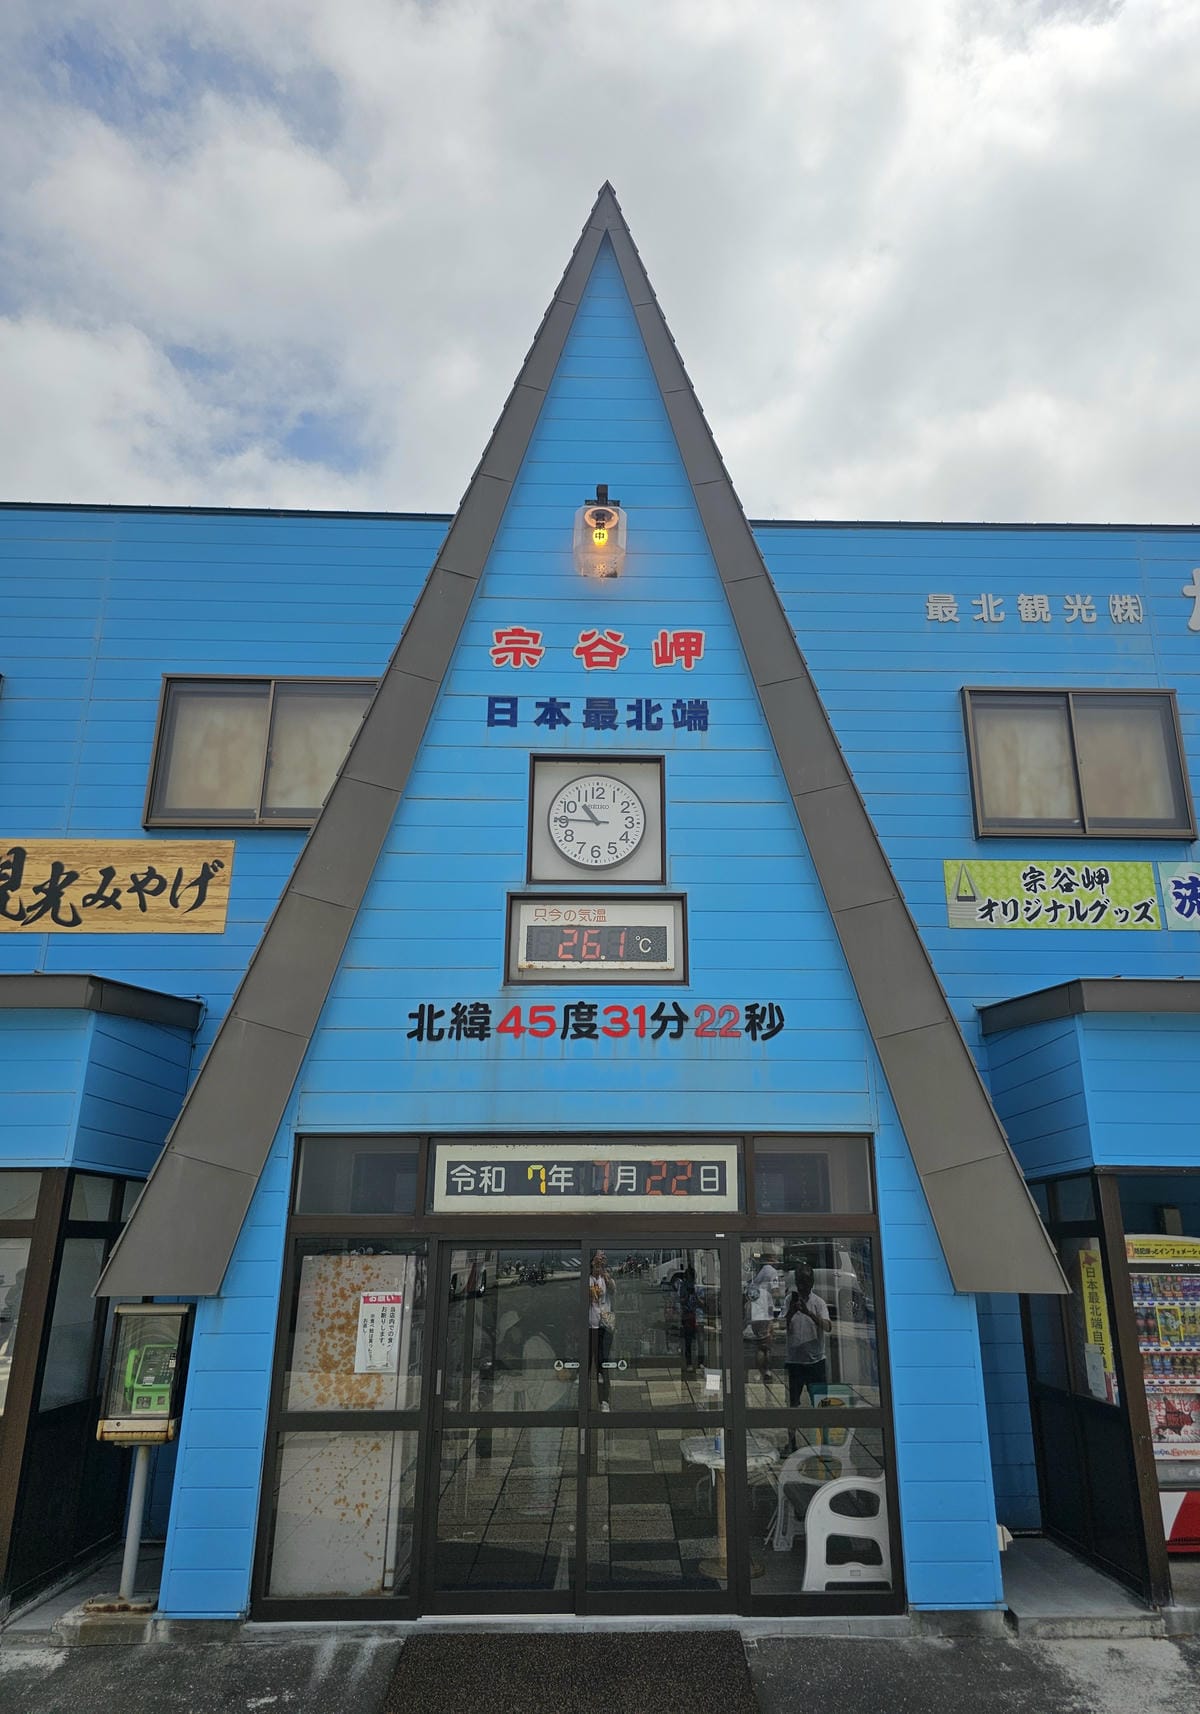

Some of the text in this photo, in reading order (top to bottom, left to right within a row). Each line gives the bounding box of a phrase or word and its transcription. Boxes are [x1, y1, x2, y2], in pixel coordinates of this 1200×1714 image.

[489, 626, 705, 671] 宗谷岬
[487, 697, 709, 732] 日本最北端
[591, 787, 605, 800] 12
[563, 801, 577, 813] 10
[620, 801, 631, 814] 2
[624, 816, 635, 829] 3
[563, 829, 574, 842] 8
[619, 831, 630, 843] 4
[576, 842, 586, 854] 7
[590, 845, 601, 858] 6
[607, 842, 617, 855] 5
[1021, 866, 1111, 895] 宗谷岬
[533, 908, 607, 922] 只今の気温
[976, 898, 1155, 924] オリジナルグッズ
[557, 929, 626, 960] 26.1
[406, 1001, 785, 1041] 北緯45度31分22秒
